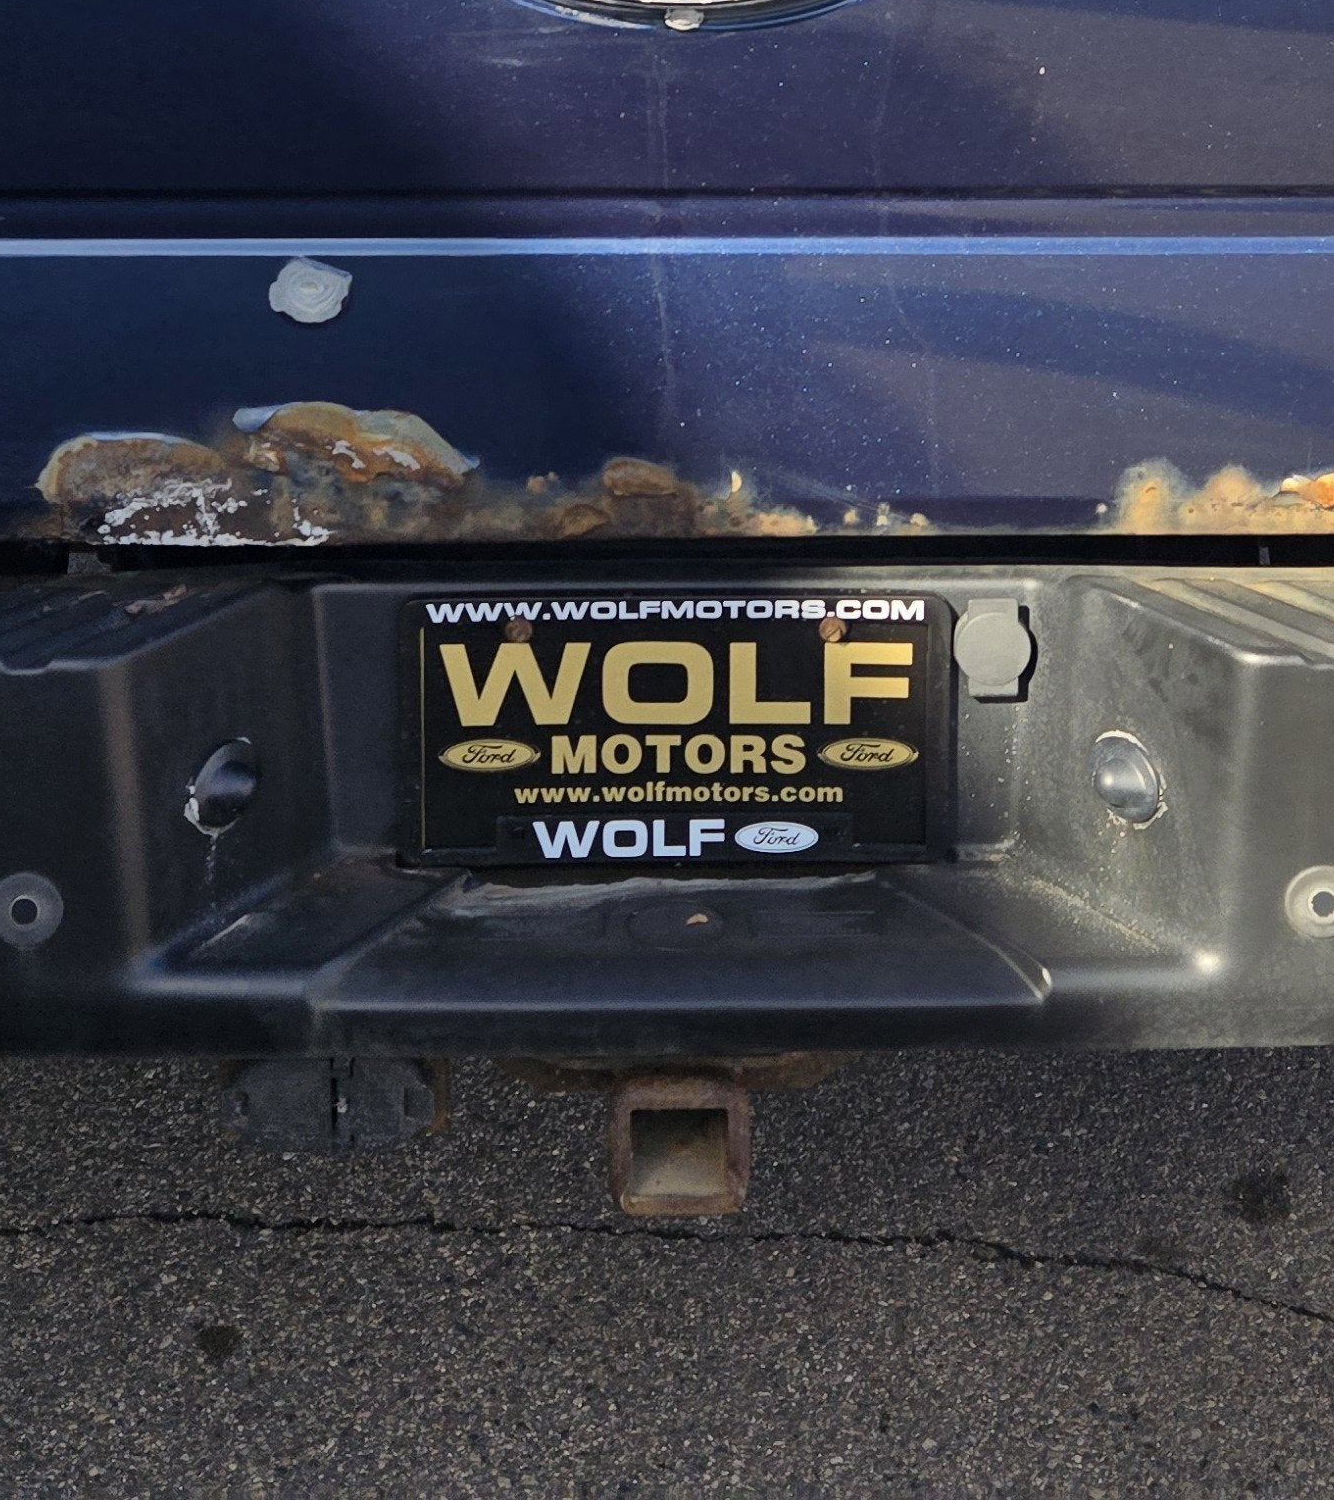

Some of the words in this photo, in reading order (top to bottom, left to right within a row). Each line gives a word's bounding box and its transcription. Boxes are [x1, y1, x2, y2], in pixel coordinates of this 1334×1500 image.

[425, 599, 925, 623] WWW.WOLFMOTORS.COM
[438, 640, 914, 727] WOLF
[461, 743, 517, 764] Ford
[551, 734, 807, 775] MOTORS
[840, 742, 895, 763] Ford
[513, 781, 844, 804] www.wolfmotors.com
[532, 818, 726, 859] WOLF
[753, 825, 800, 847] Ford
